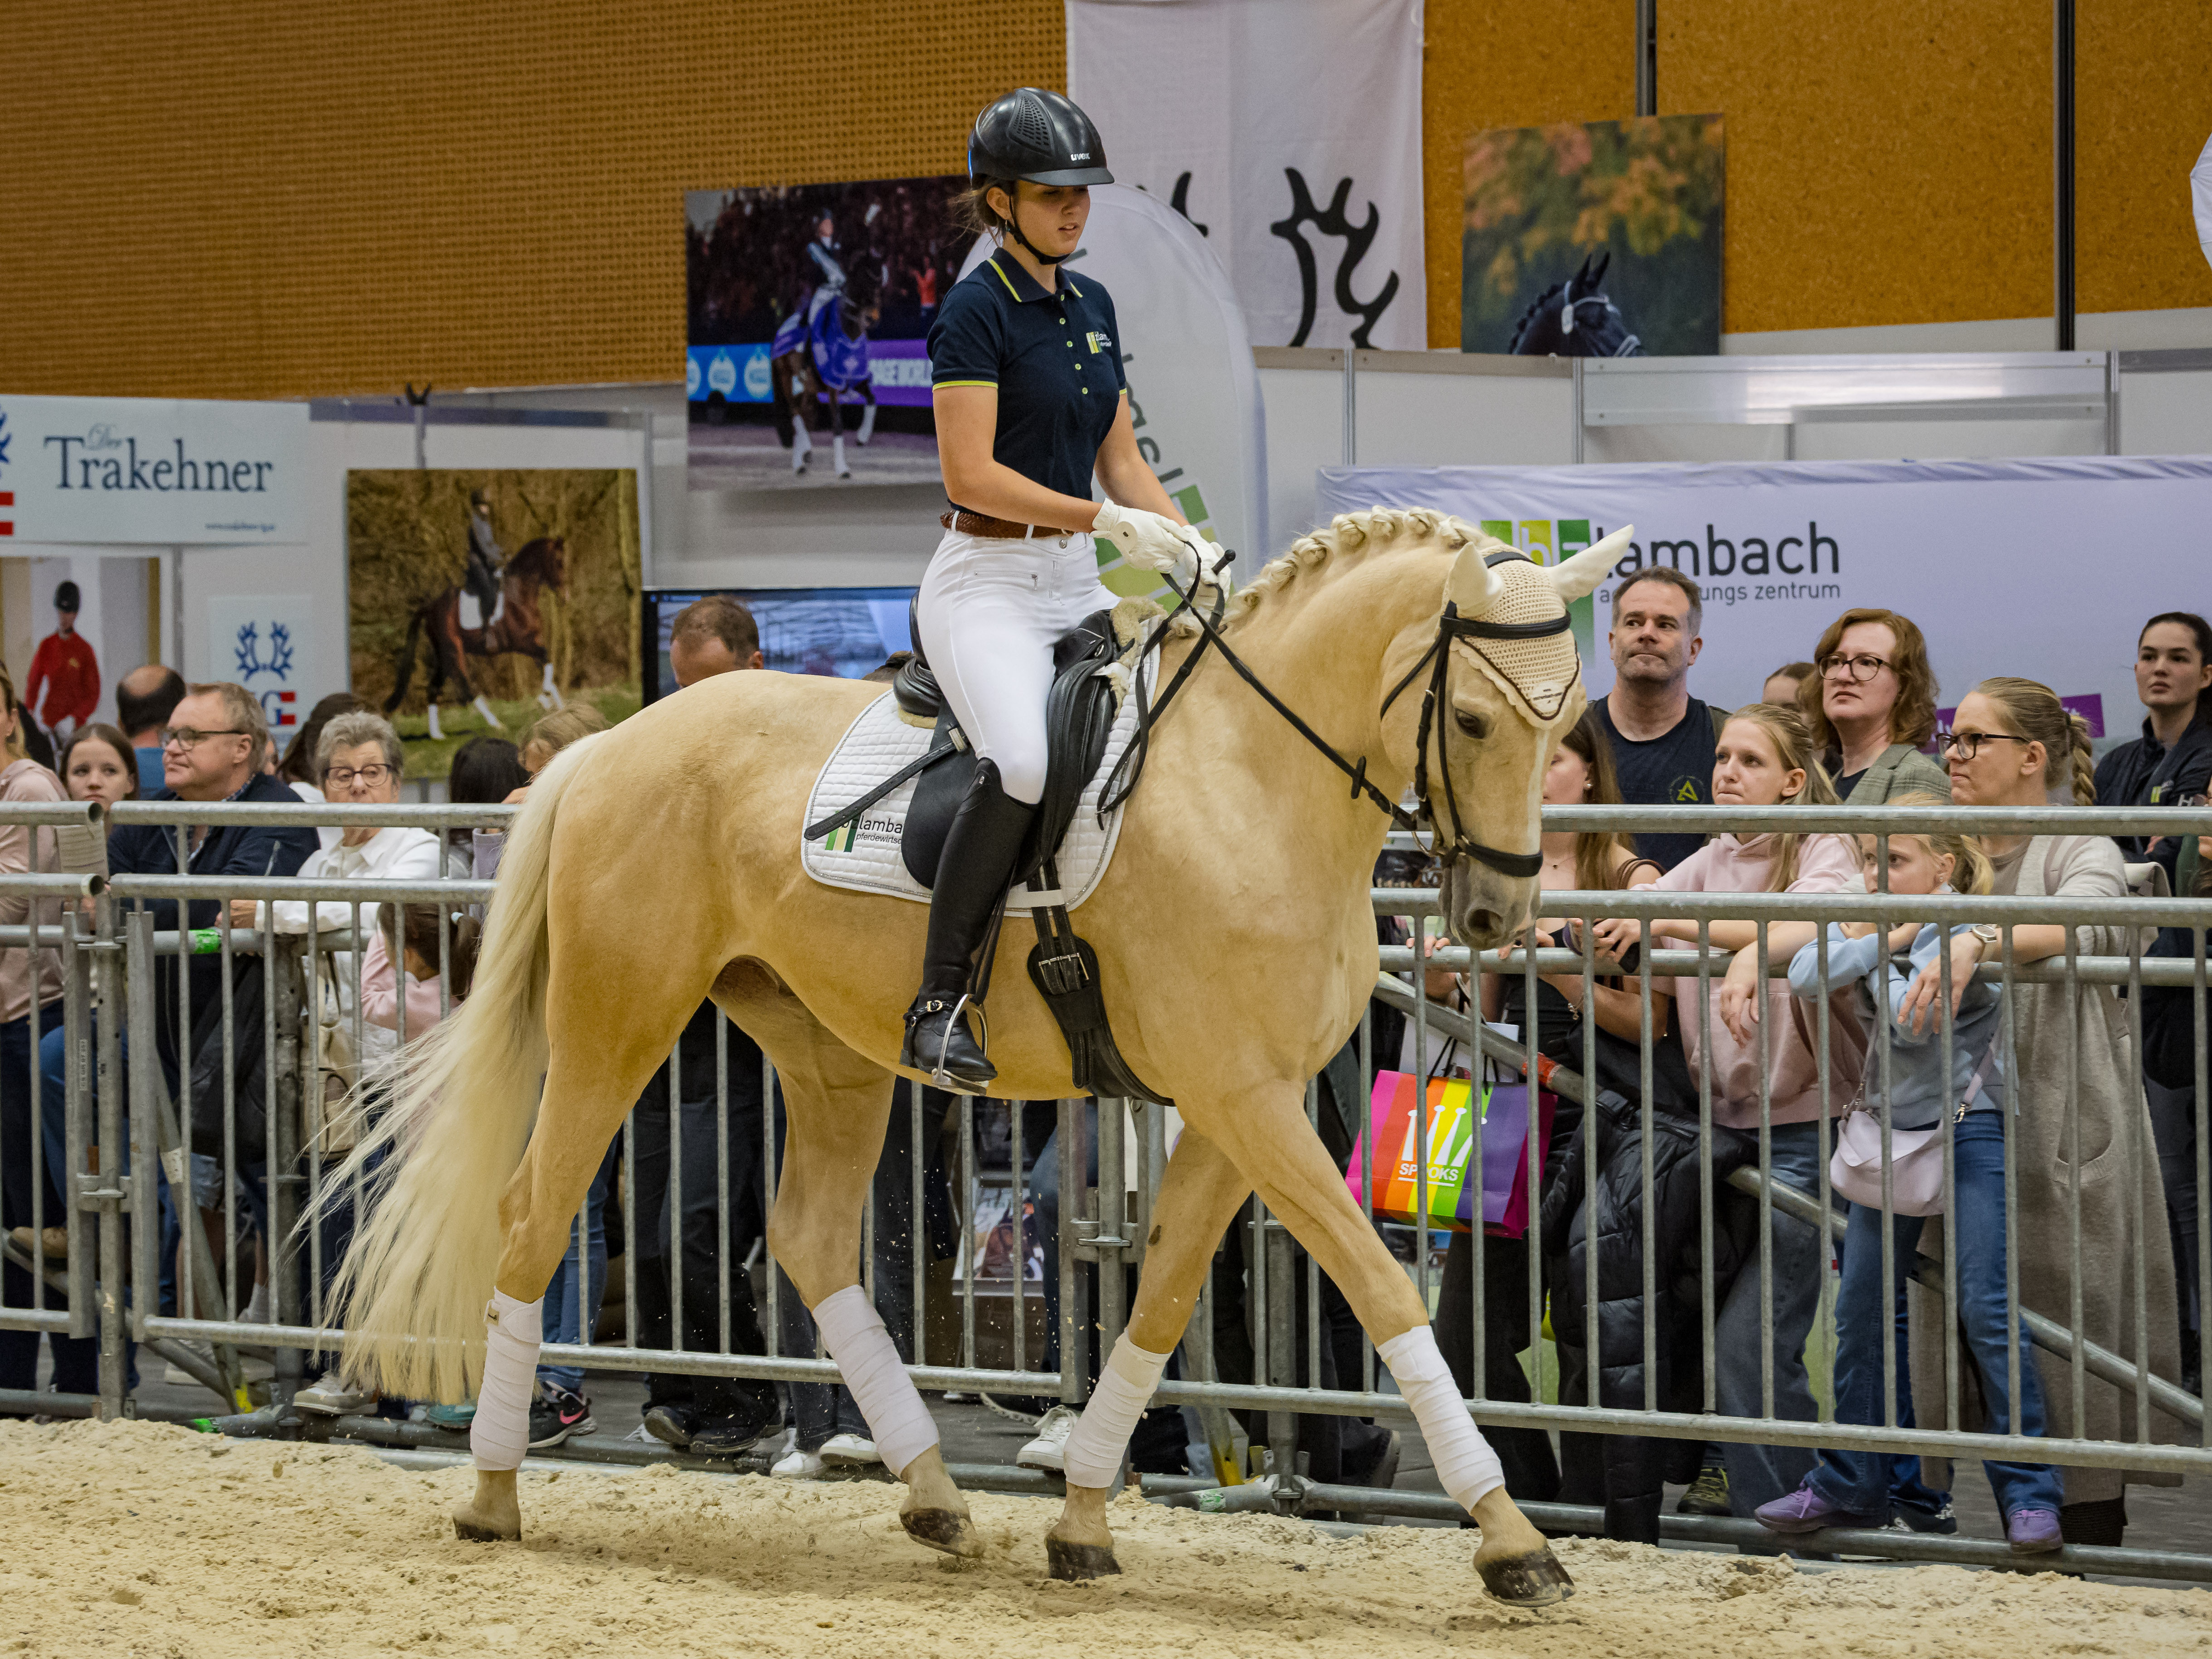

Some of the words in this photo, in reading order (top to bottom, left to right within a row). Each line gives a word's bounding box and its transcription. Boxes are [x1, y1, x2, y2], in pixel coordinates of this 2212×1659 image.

[1070, 153, 1091, 161] uvex
[44, 435, 273, 492] Trakehner
[1754, 581, 1841, 600] zentrum
[859, 815, 903, 834] lamba
[855, 832, 902, 844] pferdewirtsc
[1398, 1163, 1459, 1181] SPOKS
